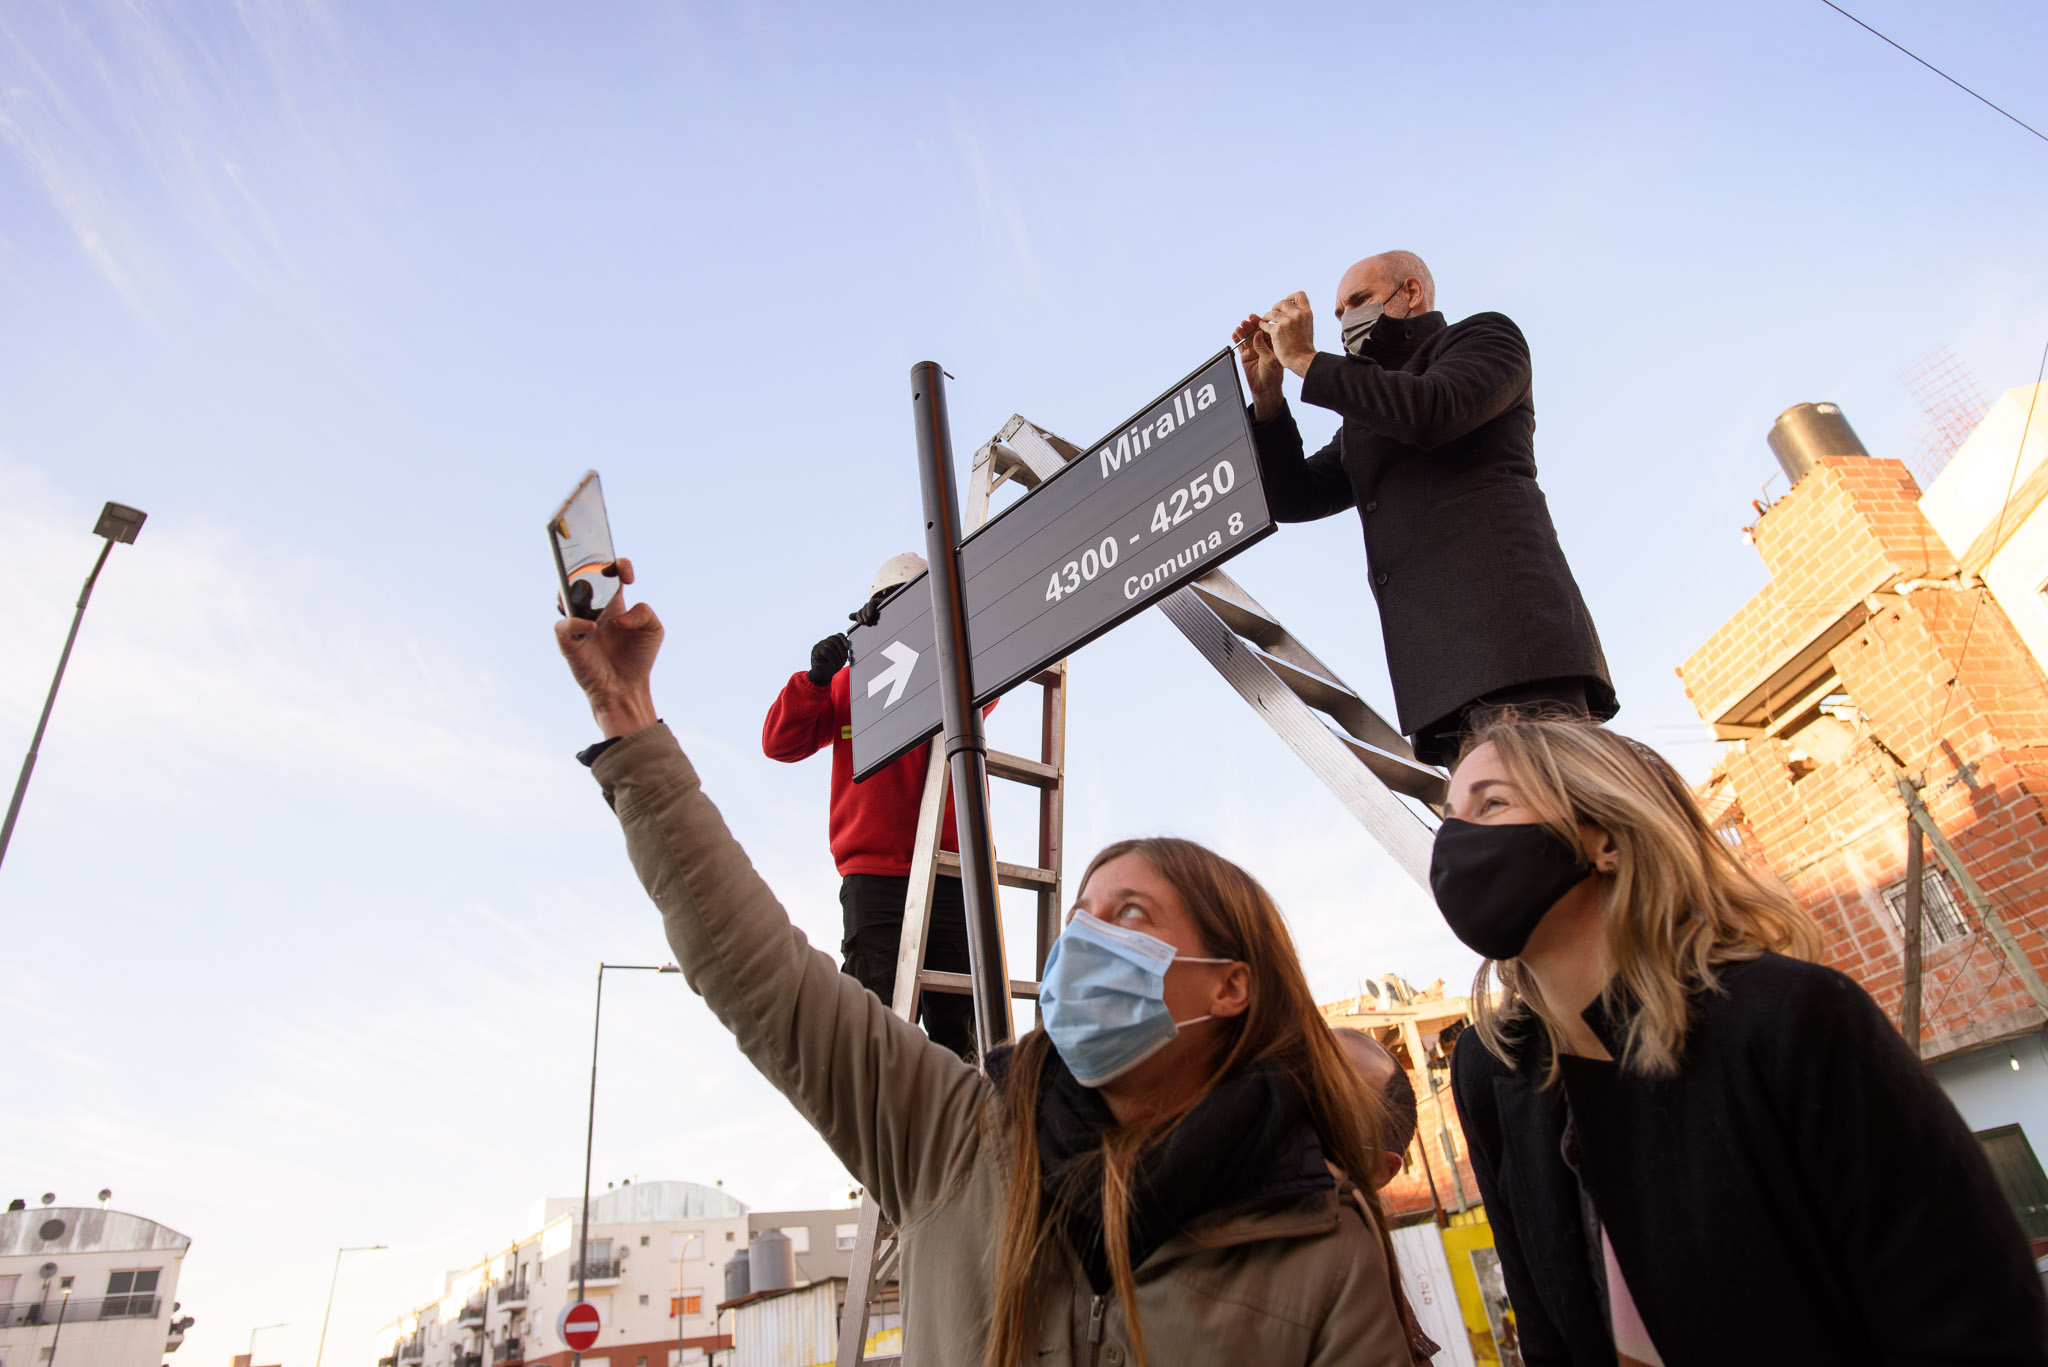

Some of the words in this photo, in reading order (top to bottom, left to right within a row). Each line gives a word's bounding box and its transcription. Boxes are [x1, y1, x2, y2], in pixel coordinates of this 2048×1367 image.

[1099, 382, 1218, 479] Miralla
[1045, 536, 1119, 602] 4300
[1129, 533, 1140, 545] -
[1150, 460, 1236, 534] 4250
[1123, 530, 1222, 600] Comuna
[1227, 511, 1244, 537] 8
